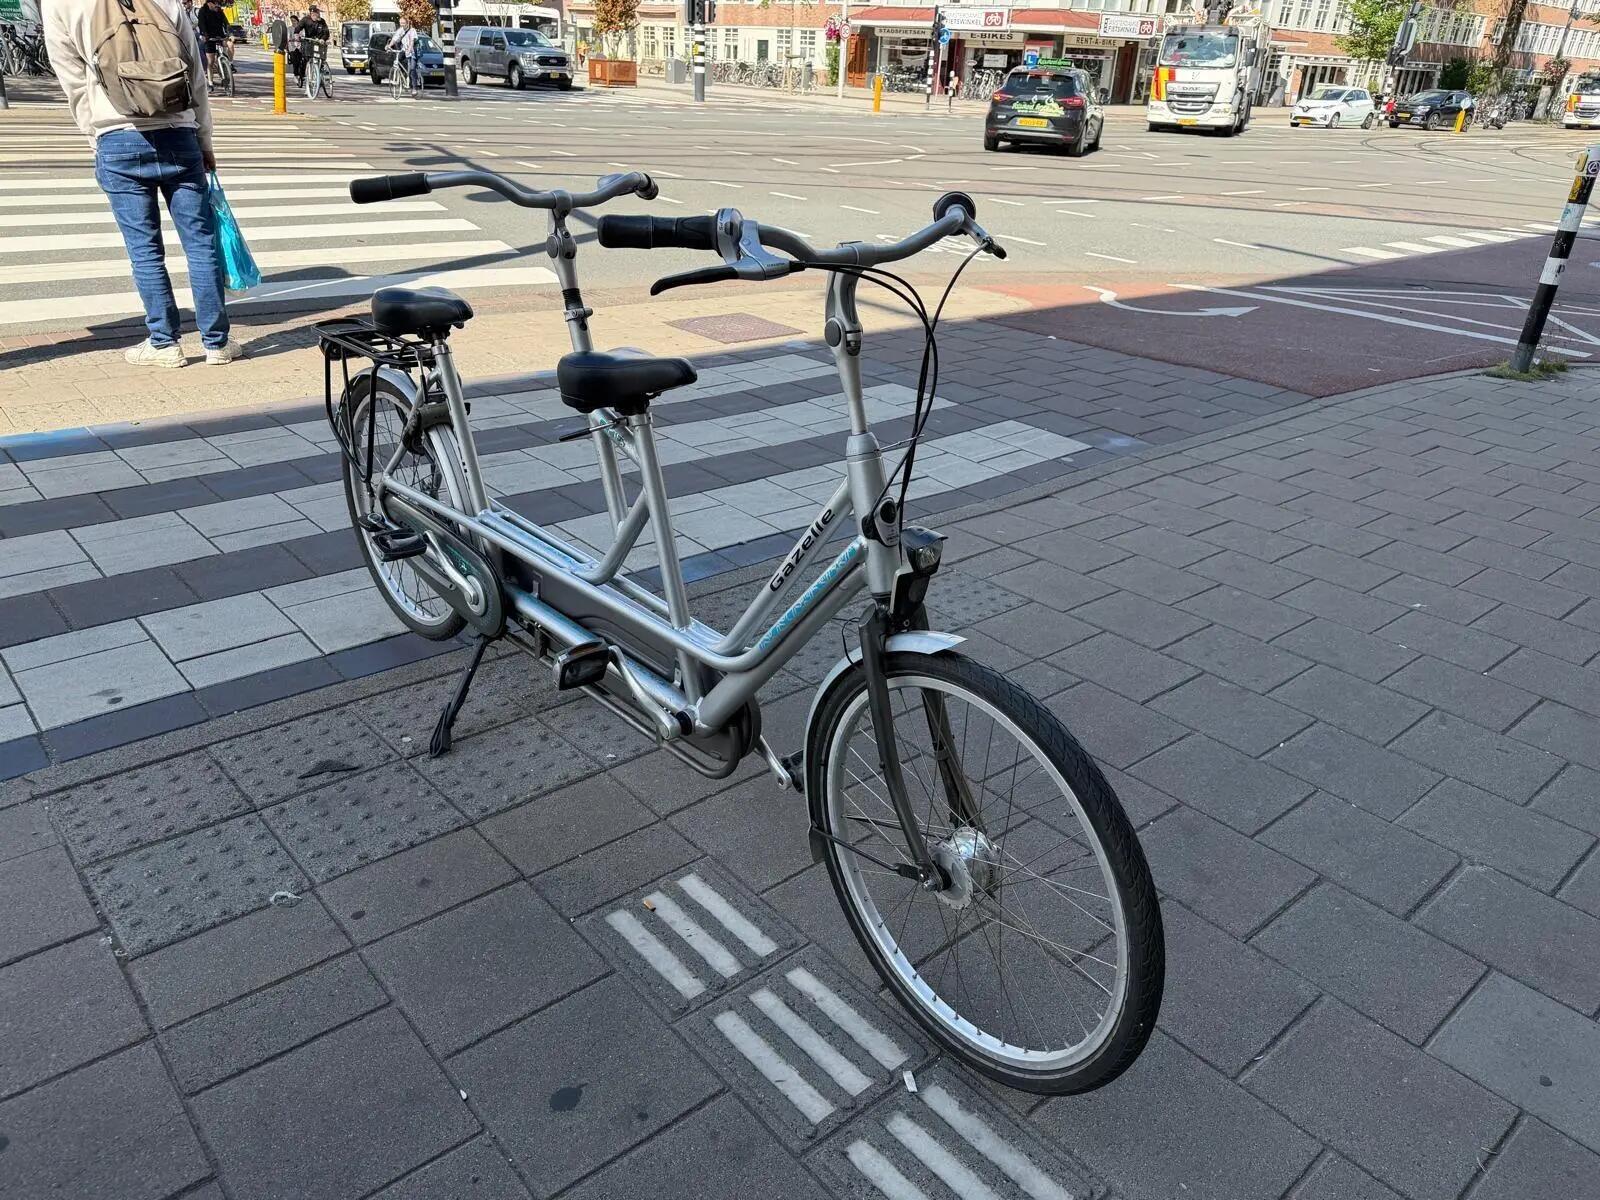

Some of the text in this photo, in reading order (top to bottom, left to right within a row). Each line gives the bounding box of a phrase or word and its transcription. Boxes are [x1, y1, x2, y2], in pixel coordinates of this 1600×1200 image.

[970, 32, 1014, 40] E-BIKES
[1076, 36, 1117, 46] RENT-A-BIKE
[769, 508, 835, 592] Gazelle
